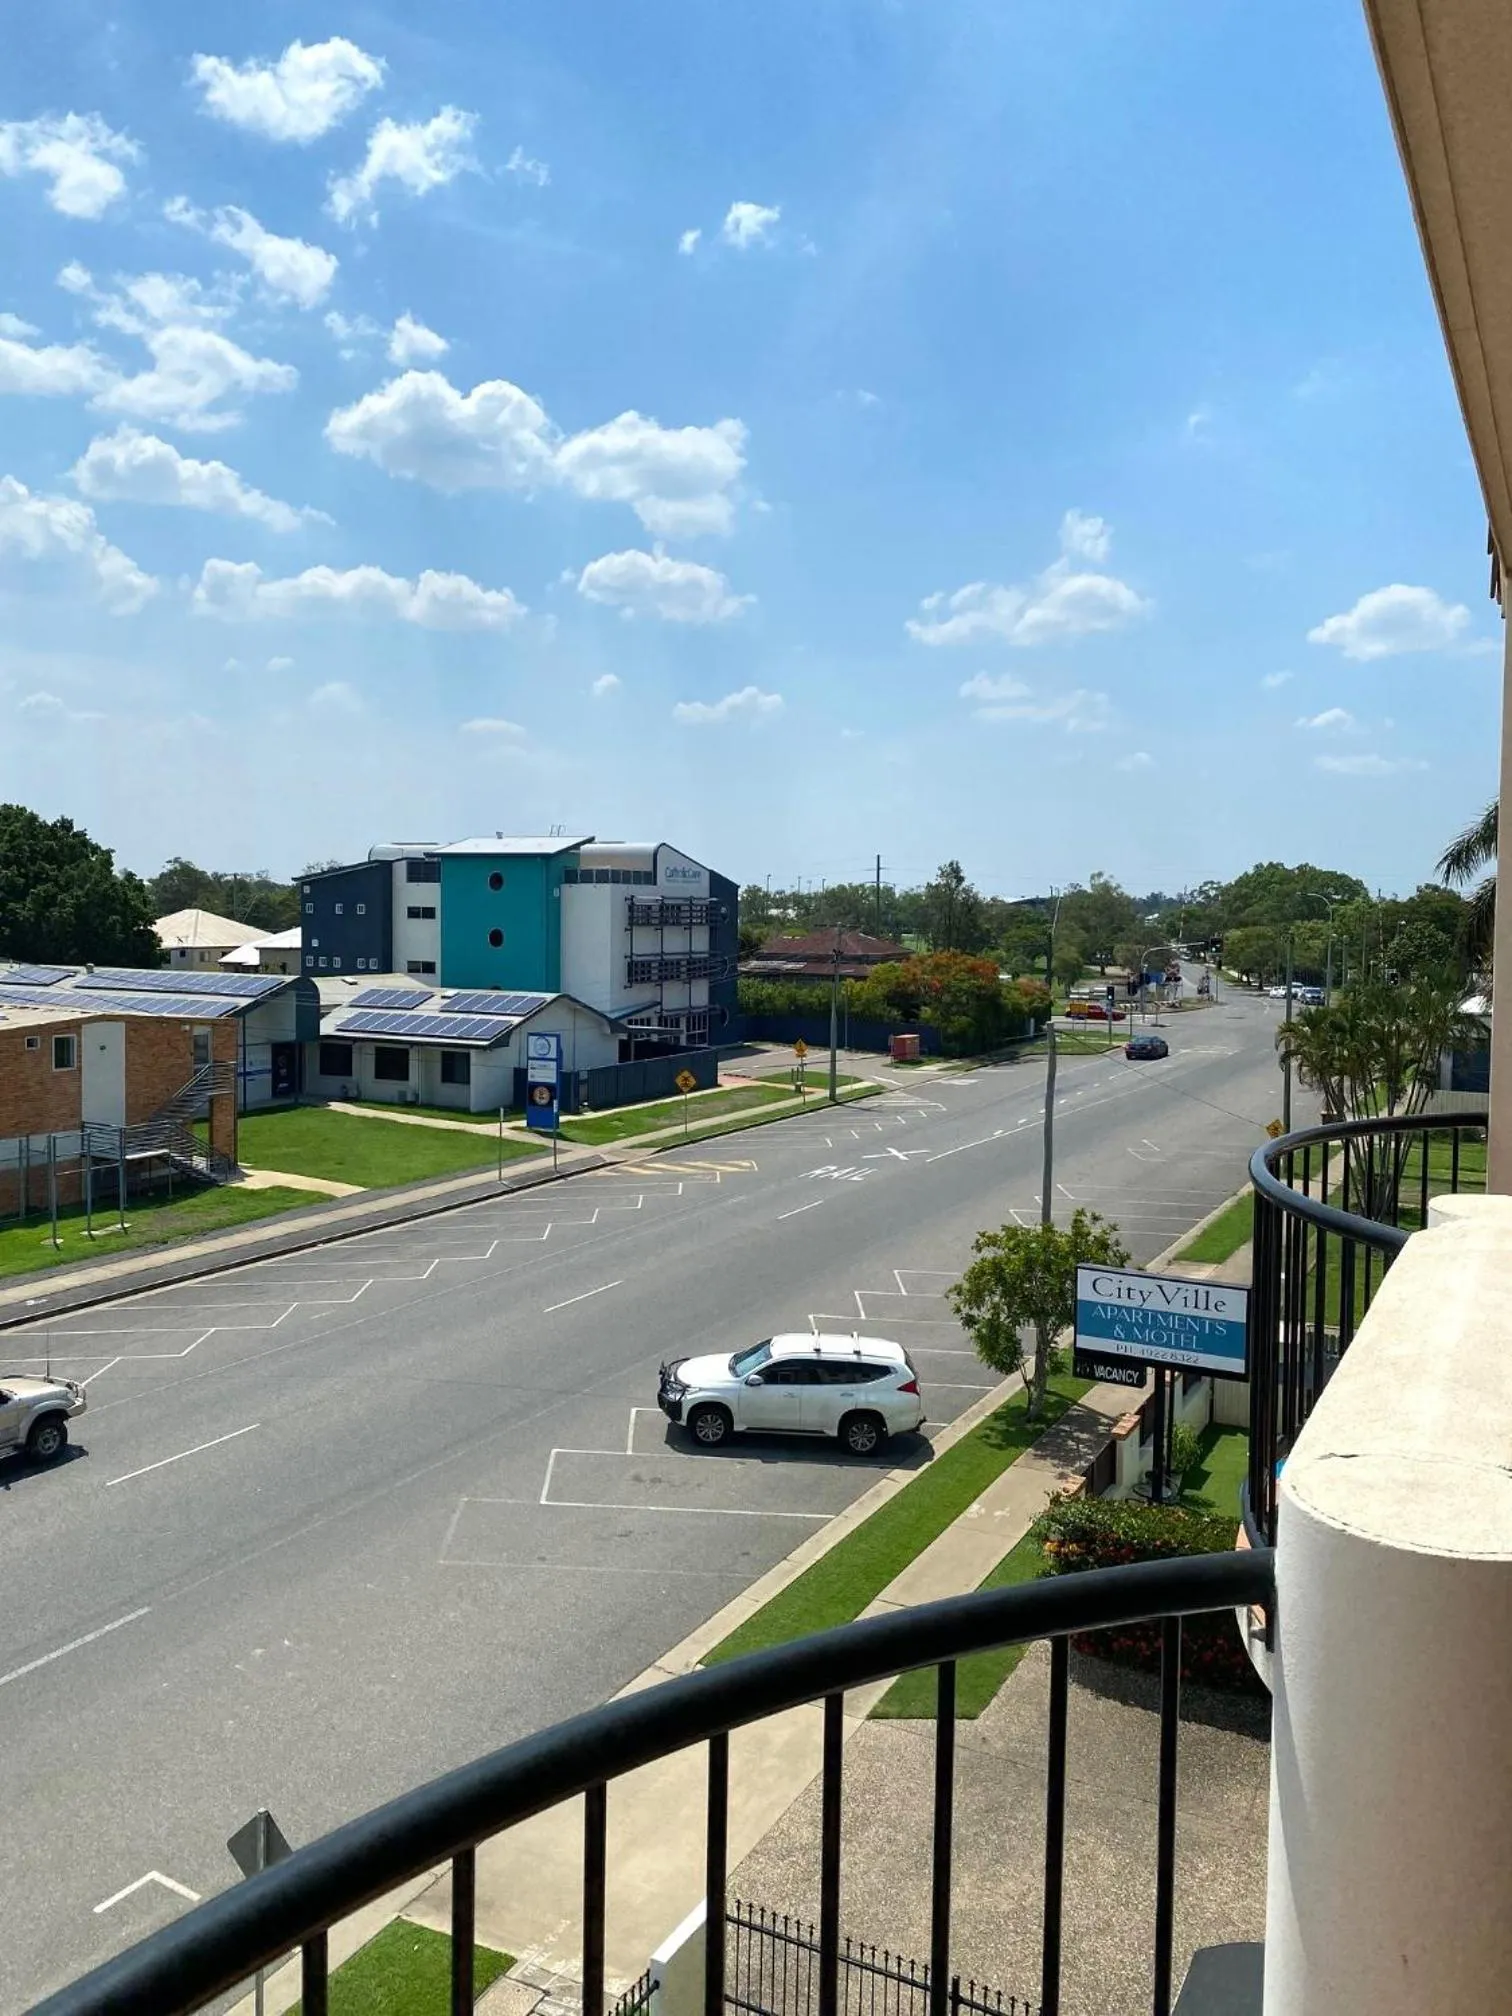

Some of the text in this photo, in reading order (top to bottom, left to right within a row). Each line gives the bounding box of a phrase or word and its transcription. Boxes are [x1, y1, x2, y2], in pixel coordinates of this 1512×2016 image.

[798, 1165, 879, 1180] RAIL
[1091, 1304, 1227, 1337] APARTMENTS
[1113, 1323, 1203, 1350] & MOTEL
[1093, 1364, 1140, 1384] VACANCY
